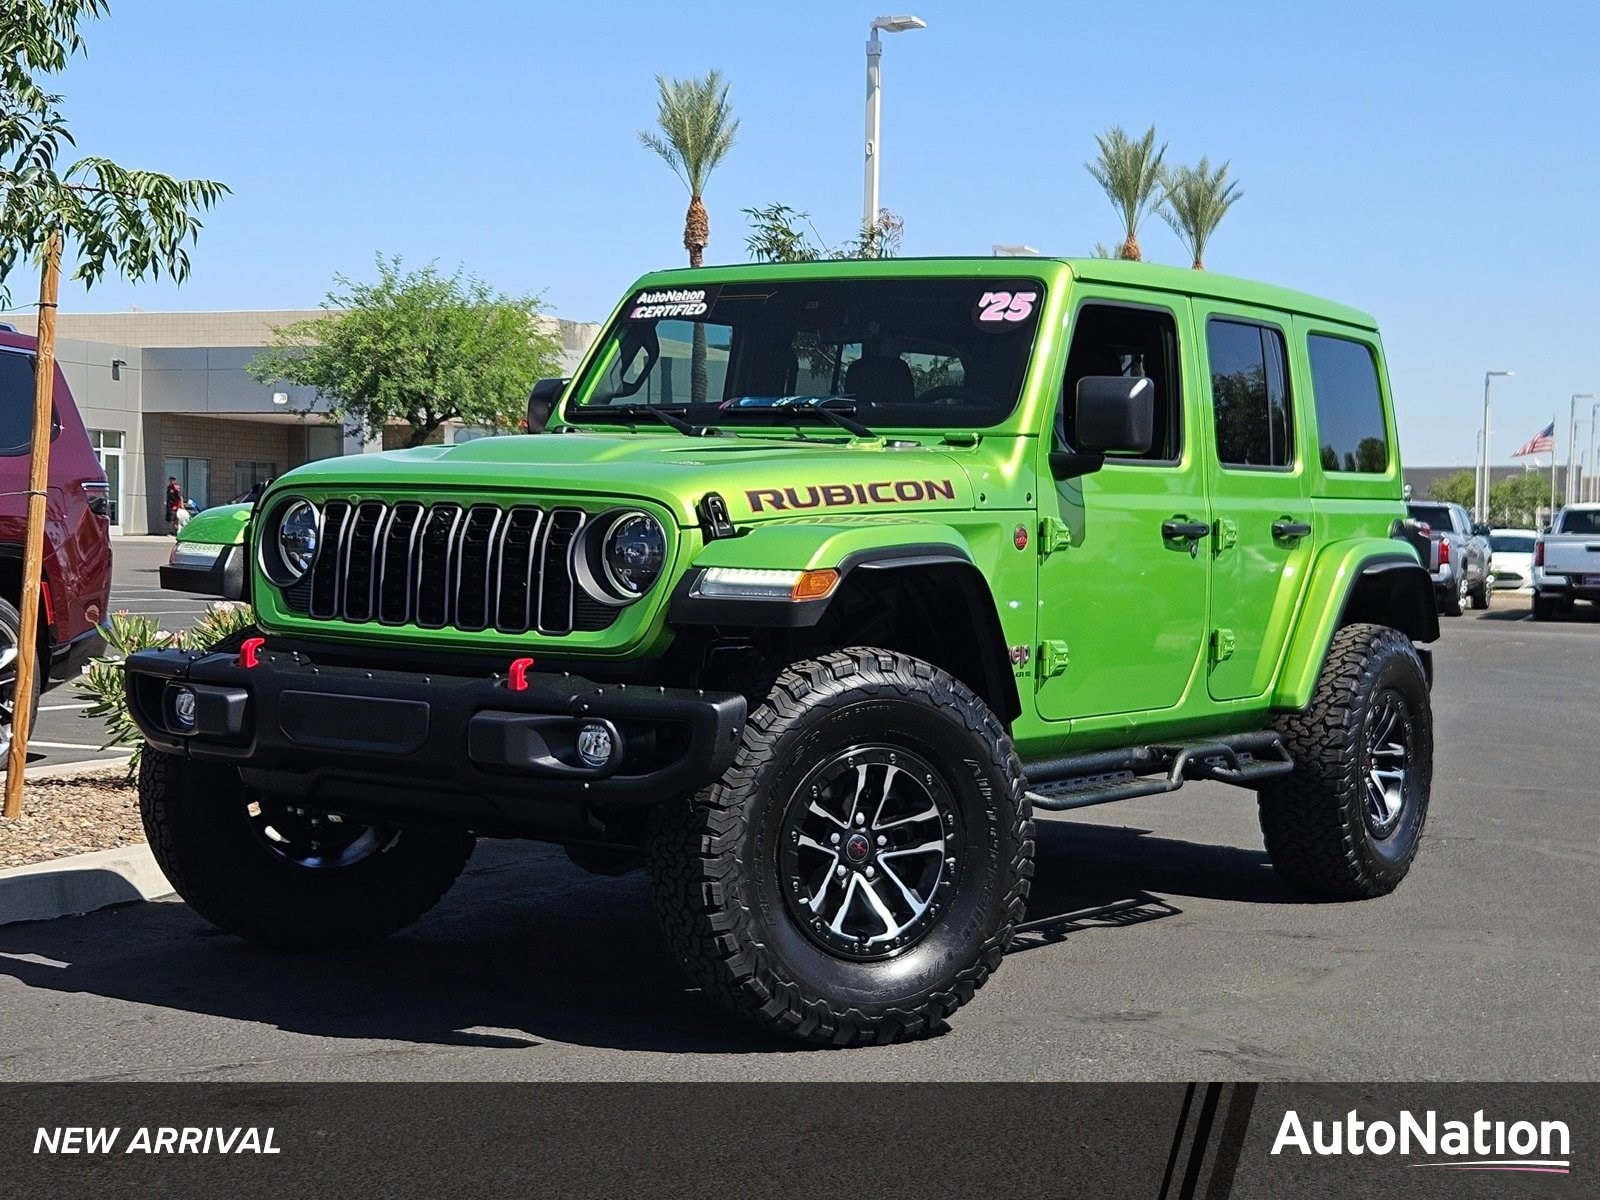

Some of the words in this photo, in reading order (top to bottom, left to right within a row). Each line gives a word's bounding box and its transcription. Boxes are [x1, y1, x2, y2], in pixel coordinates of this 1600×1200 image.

[636, 289, 706, 304] AutoNation
[978, 291, 1037, 321] '25
[636, 302, 708, 319] CERTIFIED
[744, 479, 956, 513] RUBICON
